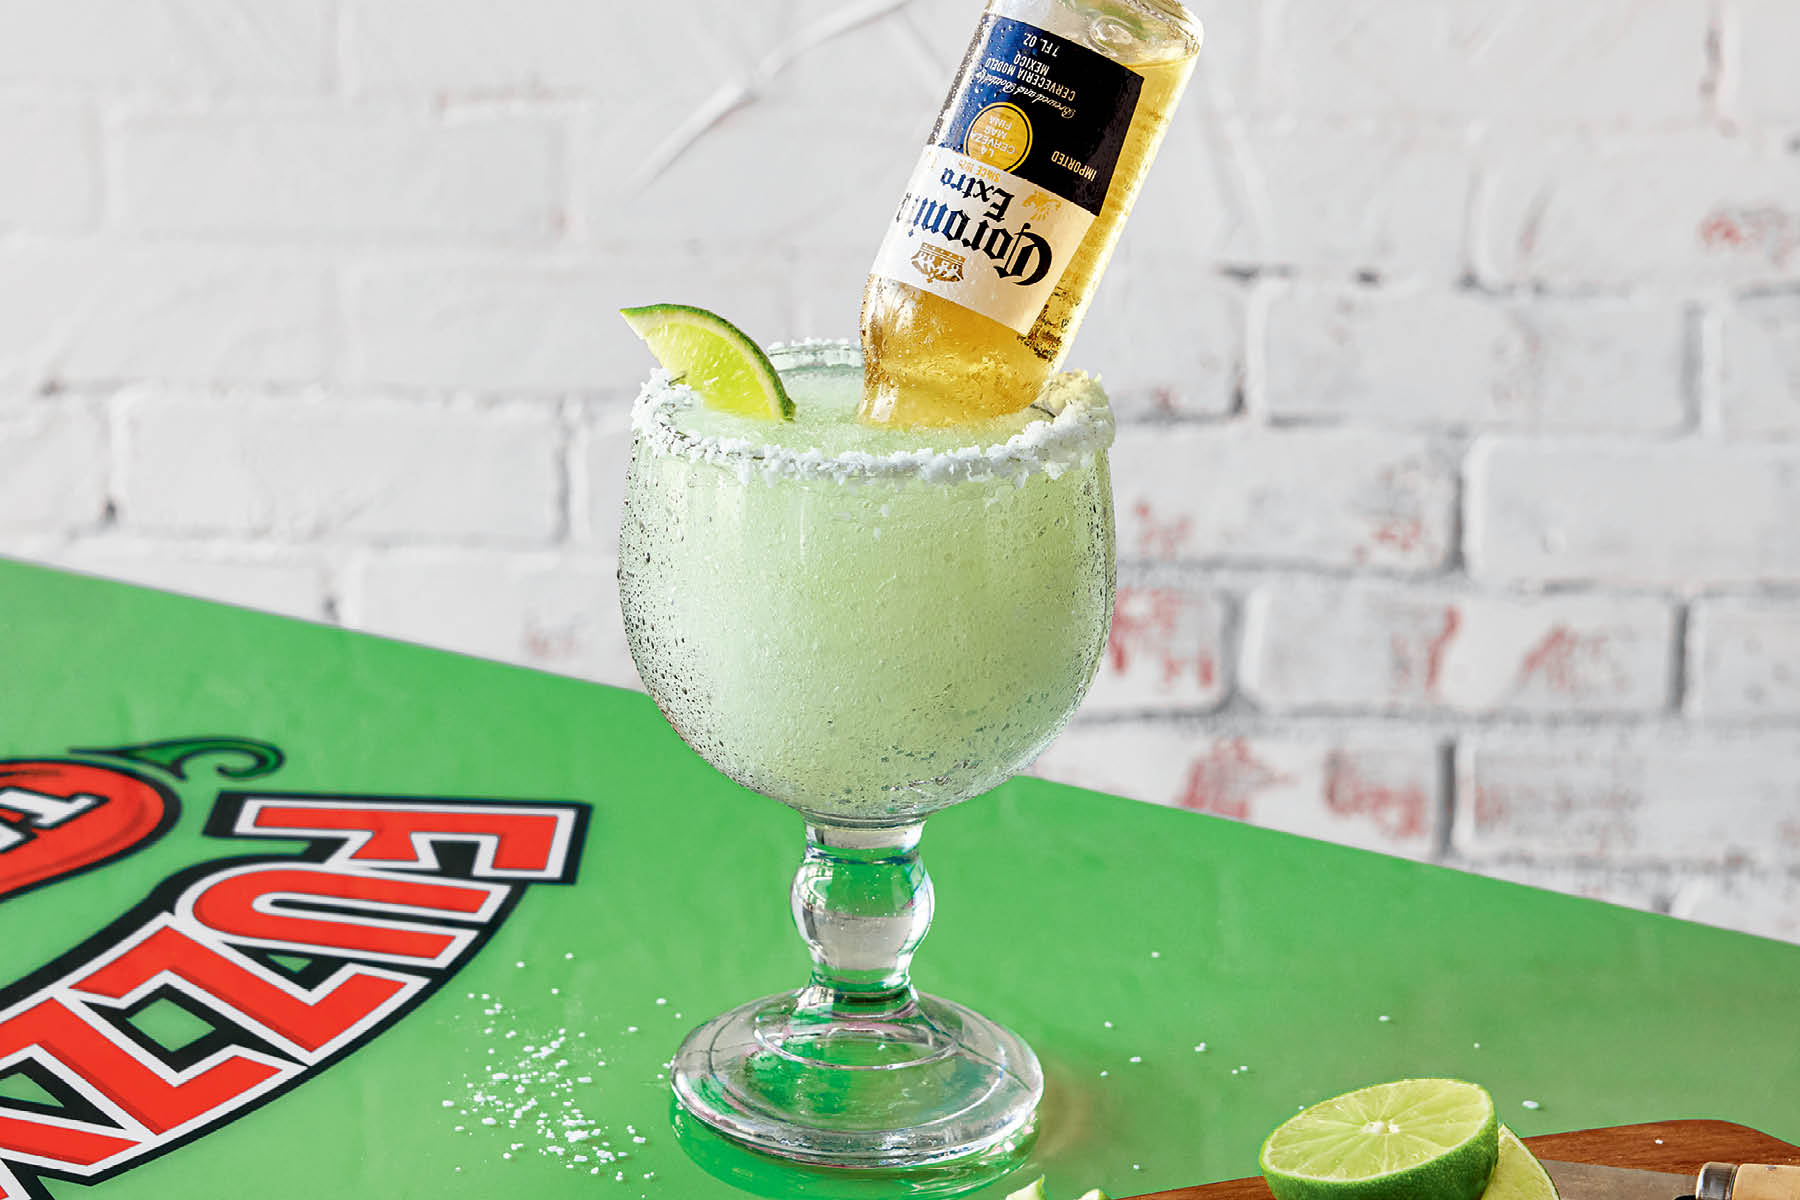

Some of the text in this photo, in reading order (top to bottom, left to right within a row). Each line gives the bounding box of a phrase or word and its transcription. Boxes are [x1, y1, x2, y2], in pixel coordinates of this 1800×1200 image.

[1037, 38, 1053, 53] FL.
[1052, 45, 1060, 57] 7
[1013, 53, 1050, 76] MEXICO
[982, 73, 1015, 94] Bottled
[984, 57, 1076, 102] CERVECERIA MODELO
[1013, 84, 1037, 99] and
[1031, 93, 1076, 120] Brewed
[988, 115, 1012, 130] FINA
[969, 130, 1016, 155] CERVEZA
[979, 146, 994, 157] LA
[975, 165, 1001, 183] SINCE
[1050, 150, 1097, 182] IMPORTED
[939, 167, 1014, 222] Extra
[896, 192, 1052, 286] Coroni
